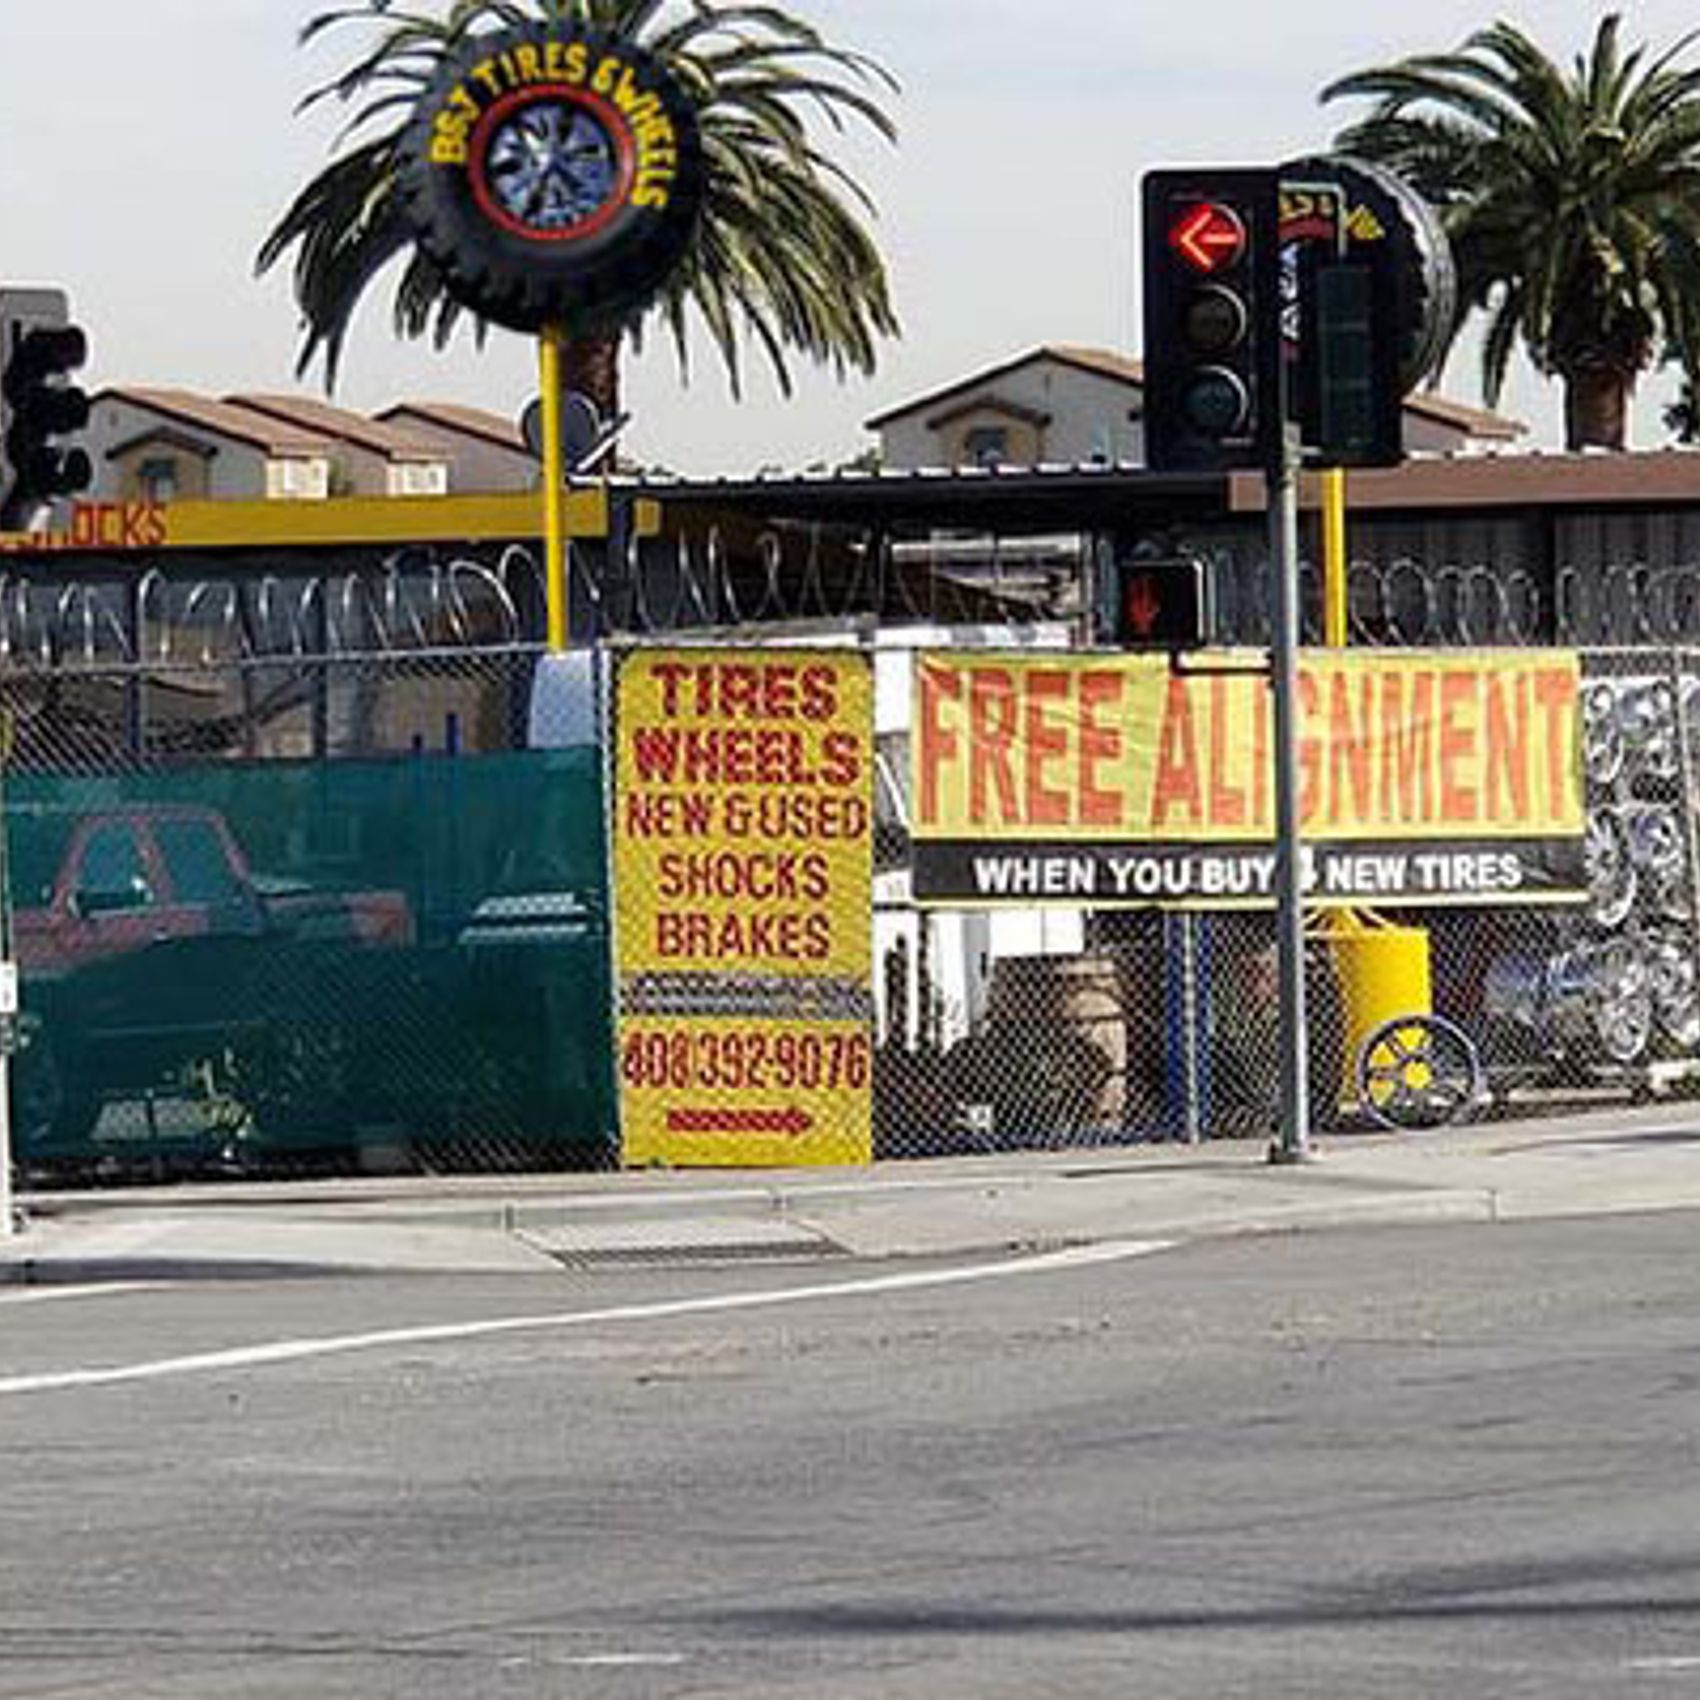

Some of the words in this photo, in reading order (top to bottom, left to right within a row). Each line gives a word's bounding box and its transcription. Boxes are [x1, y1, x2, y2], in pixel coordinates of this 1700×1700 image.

[472, 43, 588, 96] TIRES
[613, 67, 676, 207] WHEELS
[651, 664, 837, 720] TIRES
[633, 728, 860, 786] WHEELS
[918, 667, 1124, 825] FREE
[1151, 670, 1575, 826] ALIGNMENT
[627, 794, 713, 838] NEW
[759, 795, 867, 839] USED
[658, 853, 829, 899] SHOCKS
[973, 857, 1095, 894] WHEN
[1108, 857, 1191, 894] YOU
[1199, 857, 1278, 893] BUY
[1326, 854, 1405, 890] NEW
[1413, 853, 1522, 889] TIRES
[656, 913, 830, 959] BRAKES
[624, 1033, 693, 1089] 408
